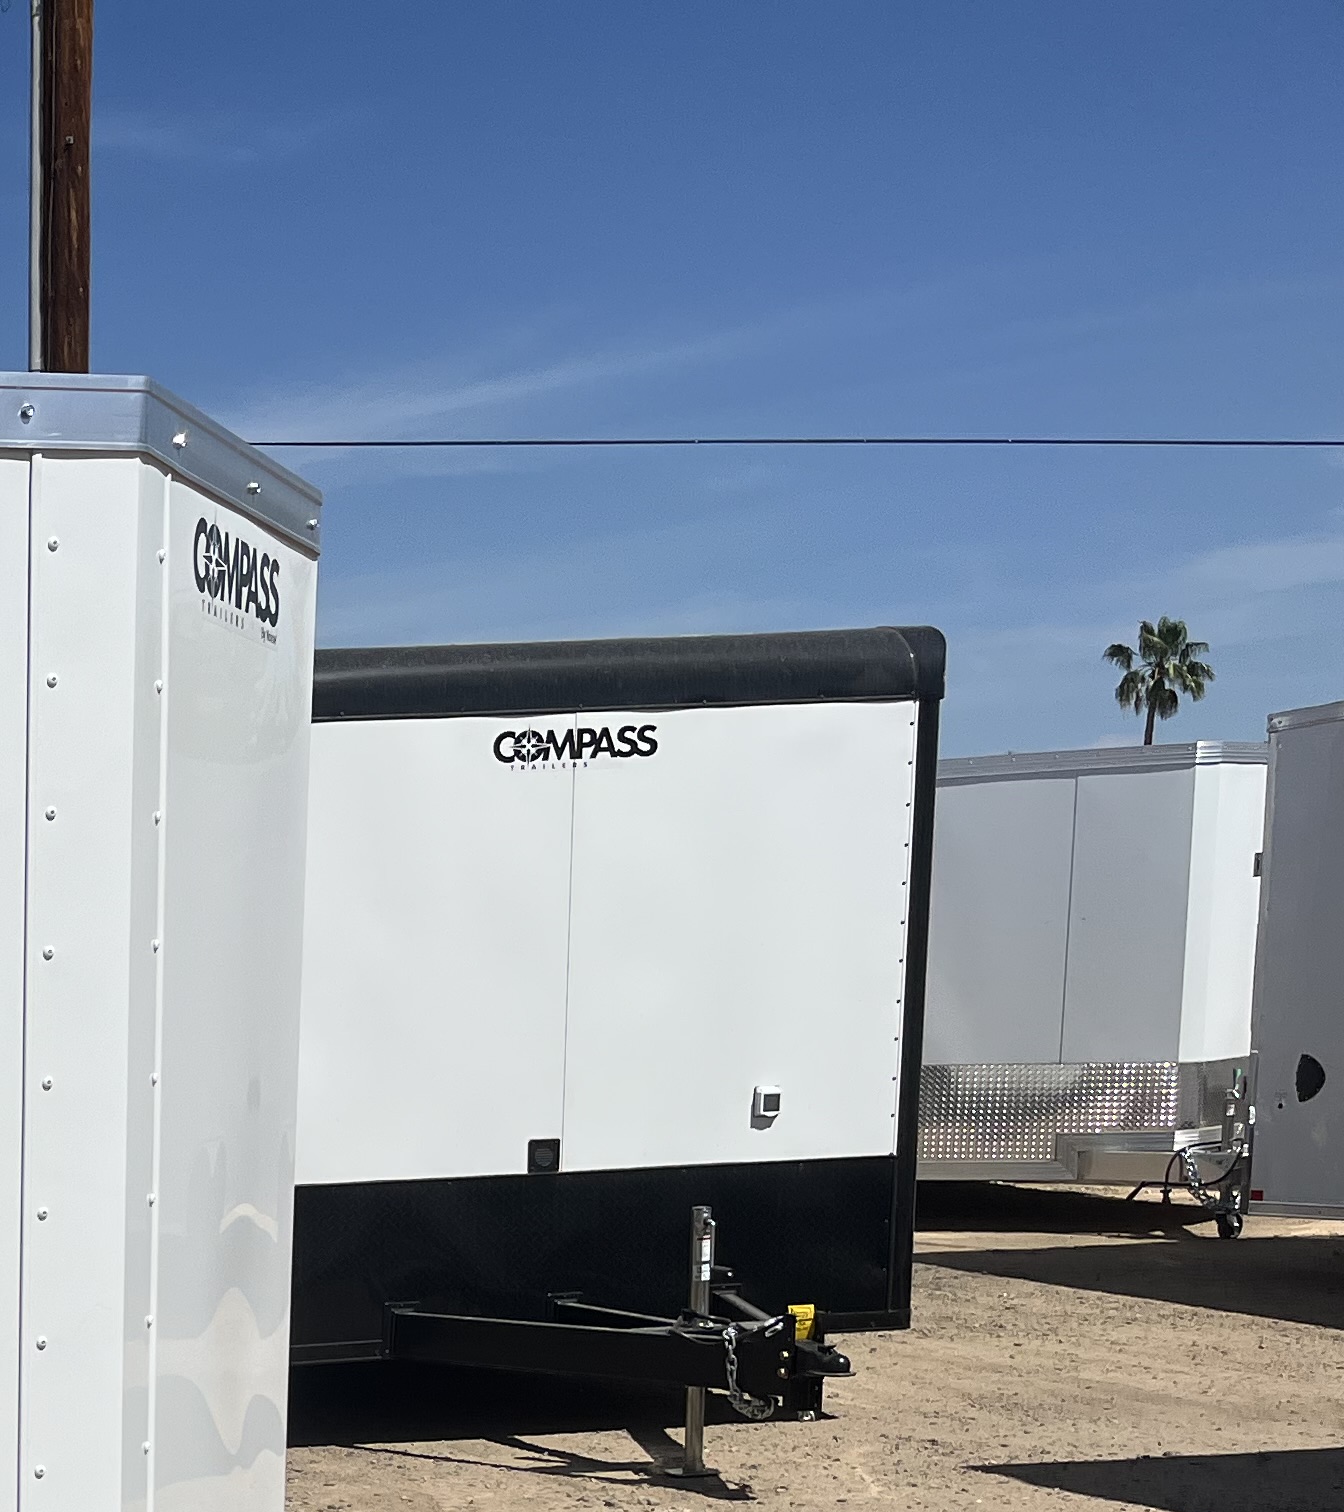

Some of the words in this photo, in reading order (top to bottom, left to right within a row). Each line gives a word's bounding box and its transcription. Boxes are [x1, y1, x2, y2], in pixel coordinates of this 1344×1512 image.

[193, 517, 280, 627] COMPASS
[493, 724, 658, 764] COMPASS
[510, 761, 588, 771] TRAILERS
